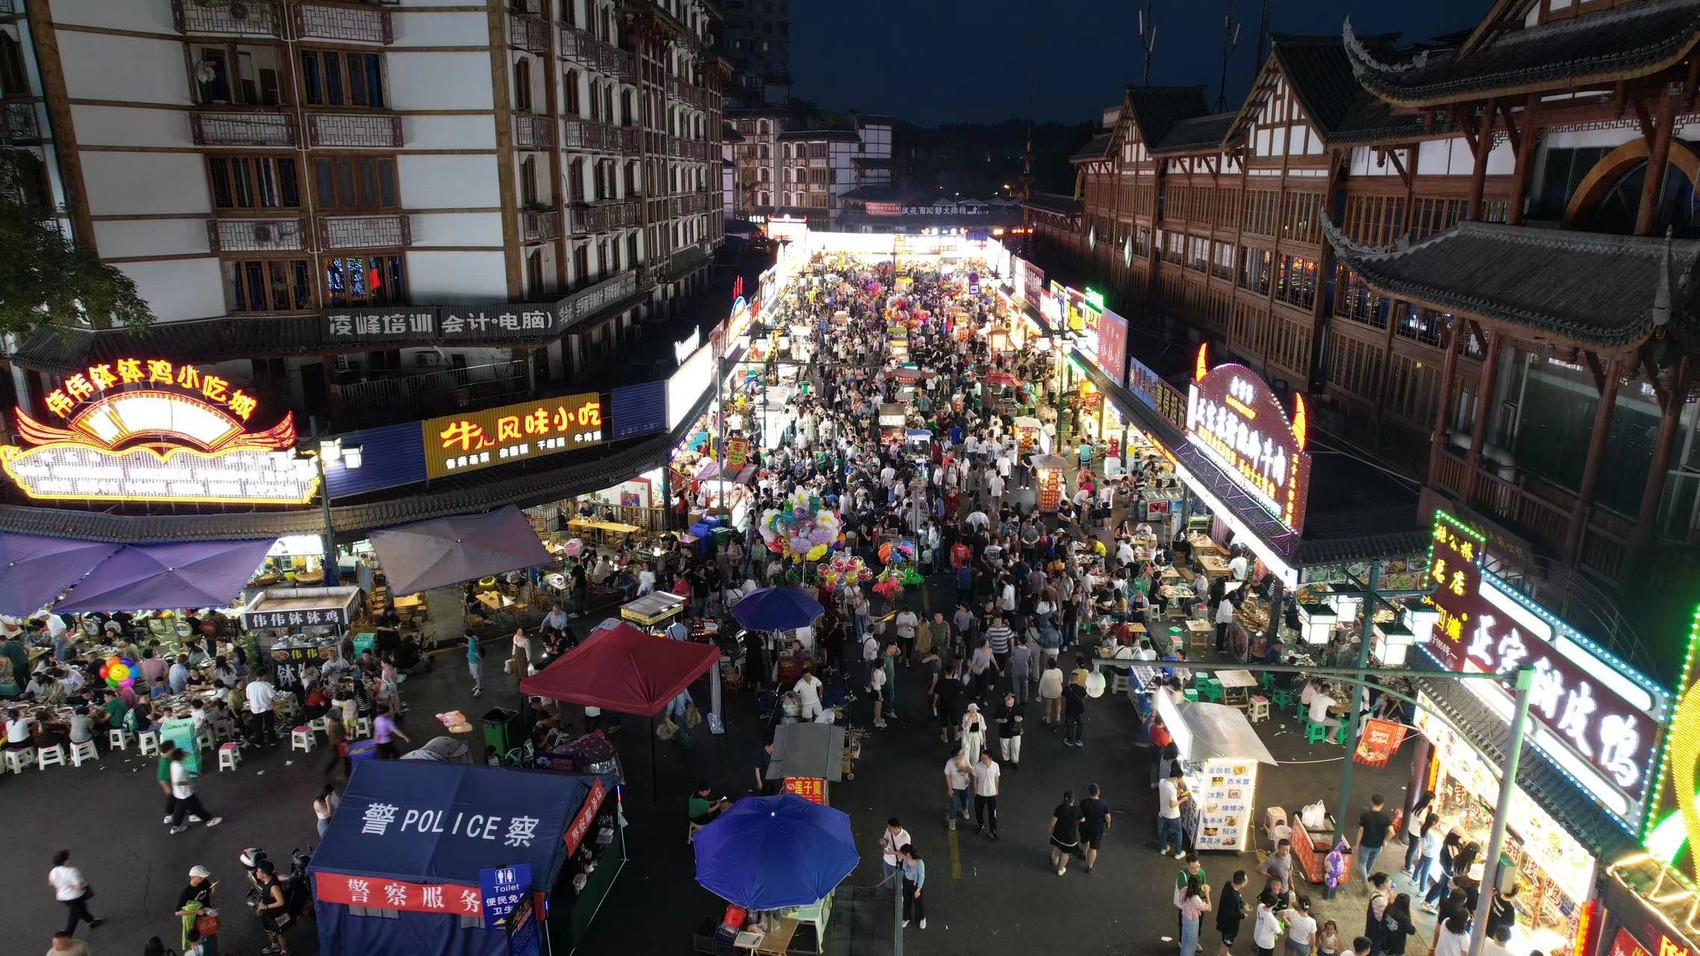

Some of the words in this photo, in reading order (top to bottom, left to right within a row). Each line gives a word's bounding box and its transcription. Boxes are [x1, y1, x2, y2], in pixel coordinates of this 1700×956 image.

[327, 312, 433, 336] 凌峰培训
[45, 357, 257, 420] 伟伟钵钵鸡小吃城
[252, 610, 339, 629] 伟伟钵钵鸡
[291, 648, 318, 660] 伟伟
[361, 802, 399, 836] 警
[401, 808, 502, 841] POLICE
[504, 814, 540, 848] 察
[347, 878, 482, 913] 警察服务
[493, 883, 520, 894] Toilet
[485, 891, 525, 908] 便民免
